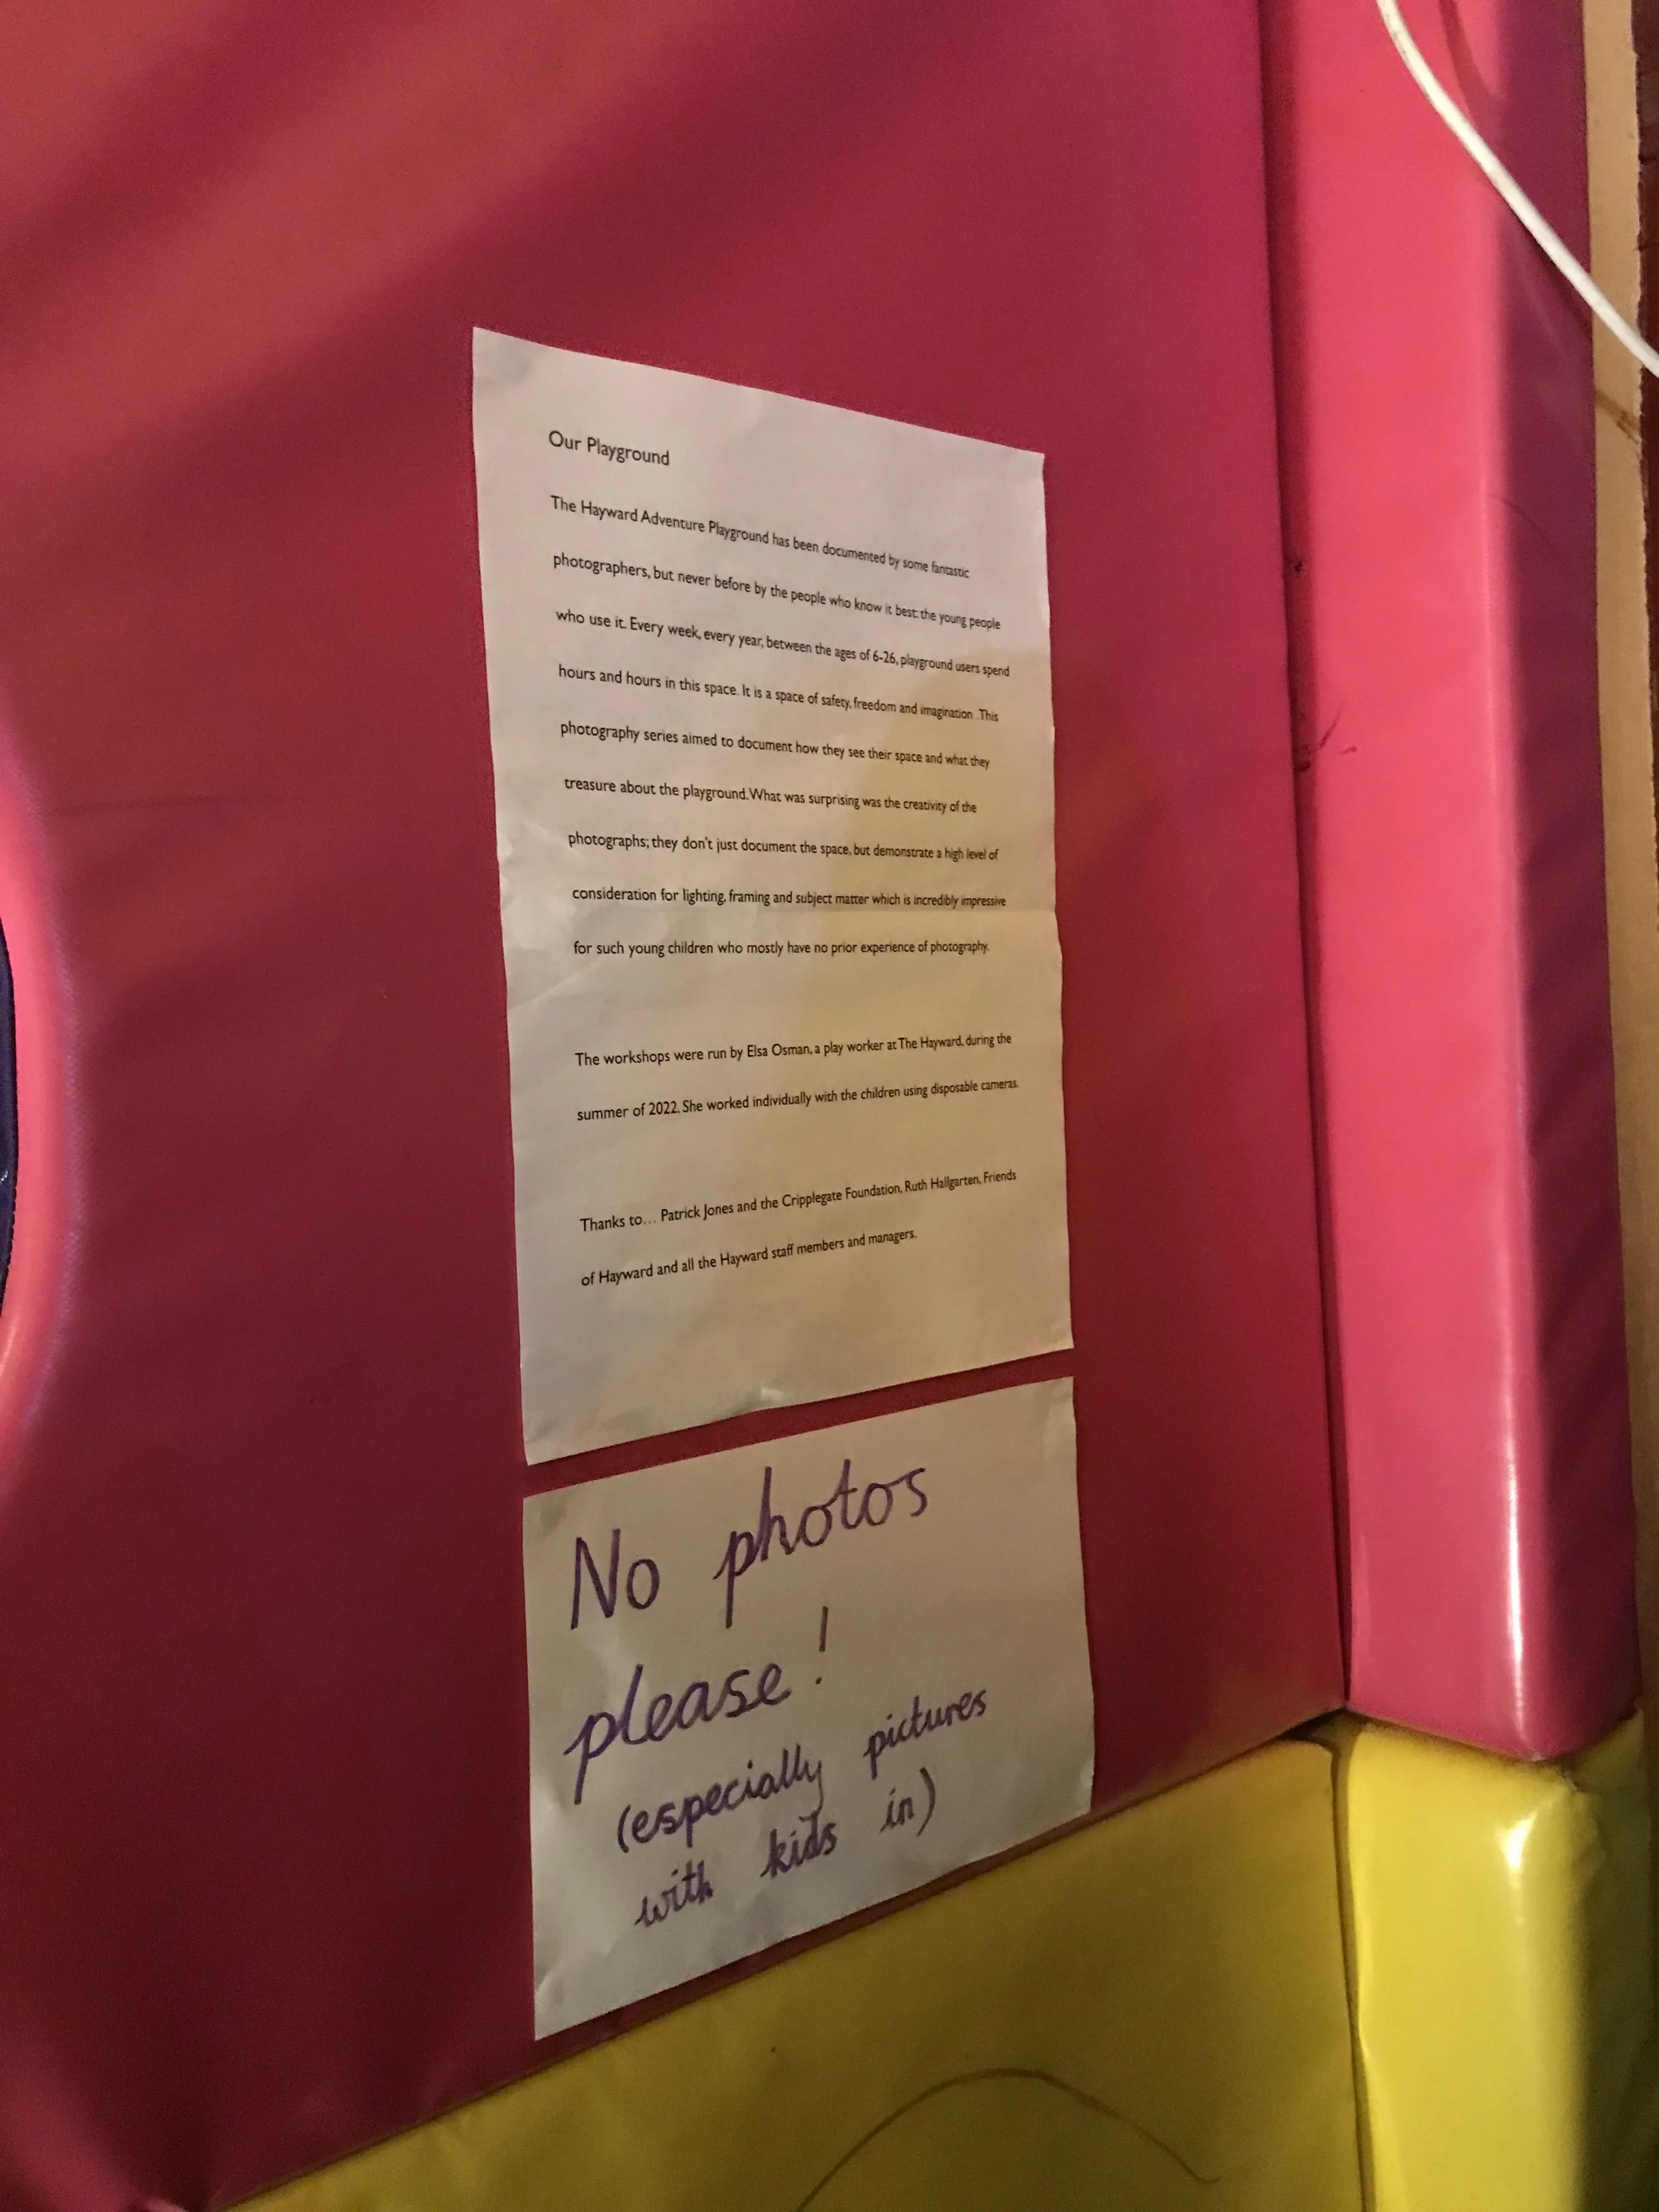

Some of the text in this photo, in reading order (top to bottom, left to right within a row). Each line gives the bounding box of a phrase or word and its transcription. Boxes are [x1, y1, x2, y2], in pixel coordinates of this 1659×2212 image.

[548, 430, 670, 467] Our Playground
[549, 494, 886, 565] The Hayward Adventure Playground has been documented
[553, 552, 1001, 631] photographers, but never before by the people who know people
[555, 609, 1010, 678] who use it. Every week, every year, between the ages of 6-26, playground users spend
[558, 663, 918, 715] hours and hours in this It a space of safety, freedom and
[560, 720, 943, 765] photography series aimed to document how they see their space and
[563, 778, 901, 810] treasure about the playground. What was surprising was the
[567, 830, 934, 859] photographs; they don't just document the space, but demonstrate
[572, 886, 901, 908] consideration for lighting, framing and subject matter which
[573, 939, 990, 958] for such young children who mostly have no prior experience of photography.
[574, 1032, 1012, 1067] The workshops were run by Elsa Osman, a play worker The Hayward, during the
[577, 1080, 979, 1122] summer of 2022. She worked individually with the children using disposable
[579, 1215, 626, 1232] Thanks
[660, 1205, 701, 1222] Patrick
[703, 1203, 734, 1221] Jones
[737, 1197, 757, 1213] and
[760, 1197, 779, 1210] the
[782, 1191, 843, 1209] Cripplegate
[845, 1183, 903, 1200] Foundation,
[904, 1179, 928, 1193] Ruth
[930, 1175, 982, 1191] Hallgarten,
[983, 1168, 1017, 1183] Friends
[581, 1230, 918, 1287] of Hayward and all the Hayward staff members and managers.
[569, 1457, 928, 1631] No photos
[616, 1688, 987, 1854] (especially pictures
[633, 1858, 715, 1929] with
[759, 1809, 838, 1880] kids
